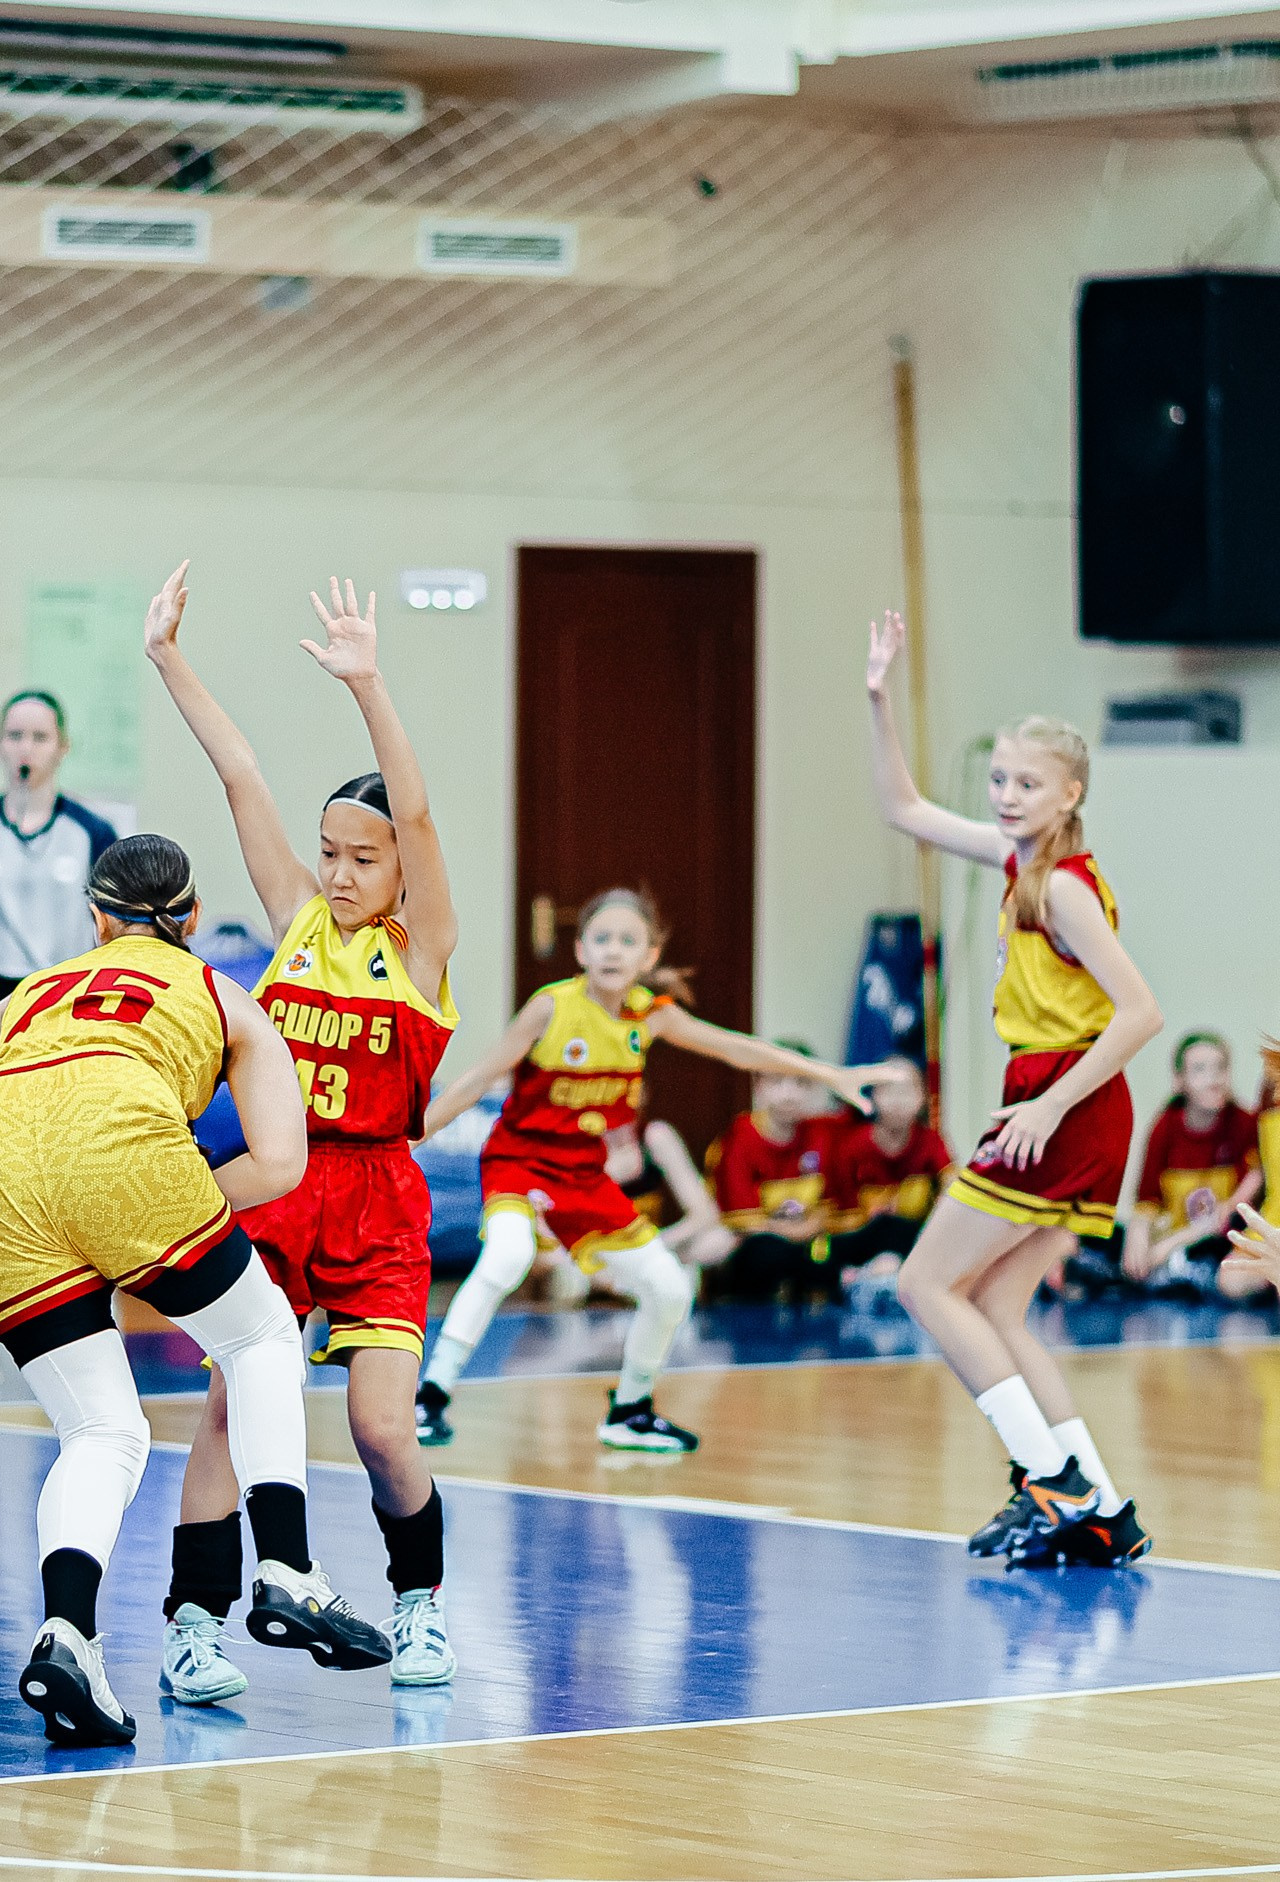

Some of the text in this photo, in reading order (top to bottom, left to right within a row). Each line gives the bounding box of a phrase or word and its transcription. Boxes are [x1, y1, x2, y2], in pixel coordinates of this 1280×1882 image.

[5, 967, 171, 1044] 75
[267, 998, 393, 1055] СШОР 5
